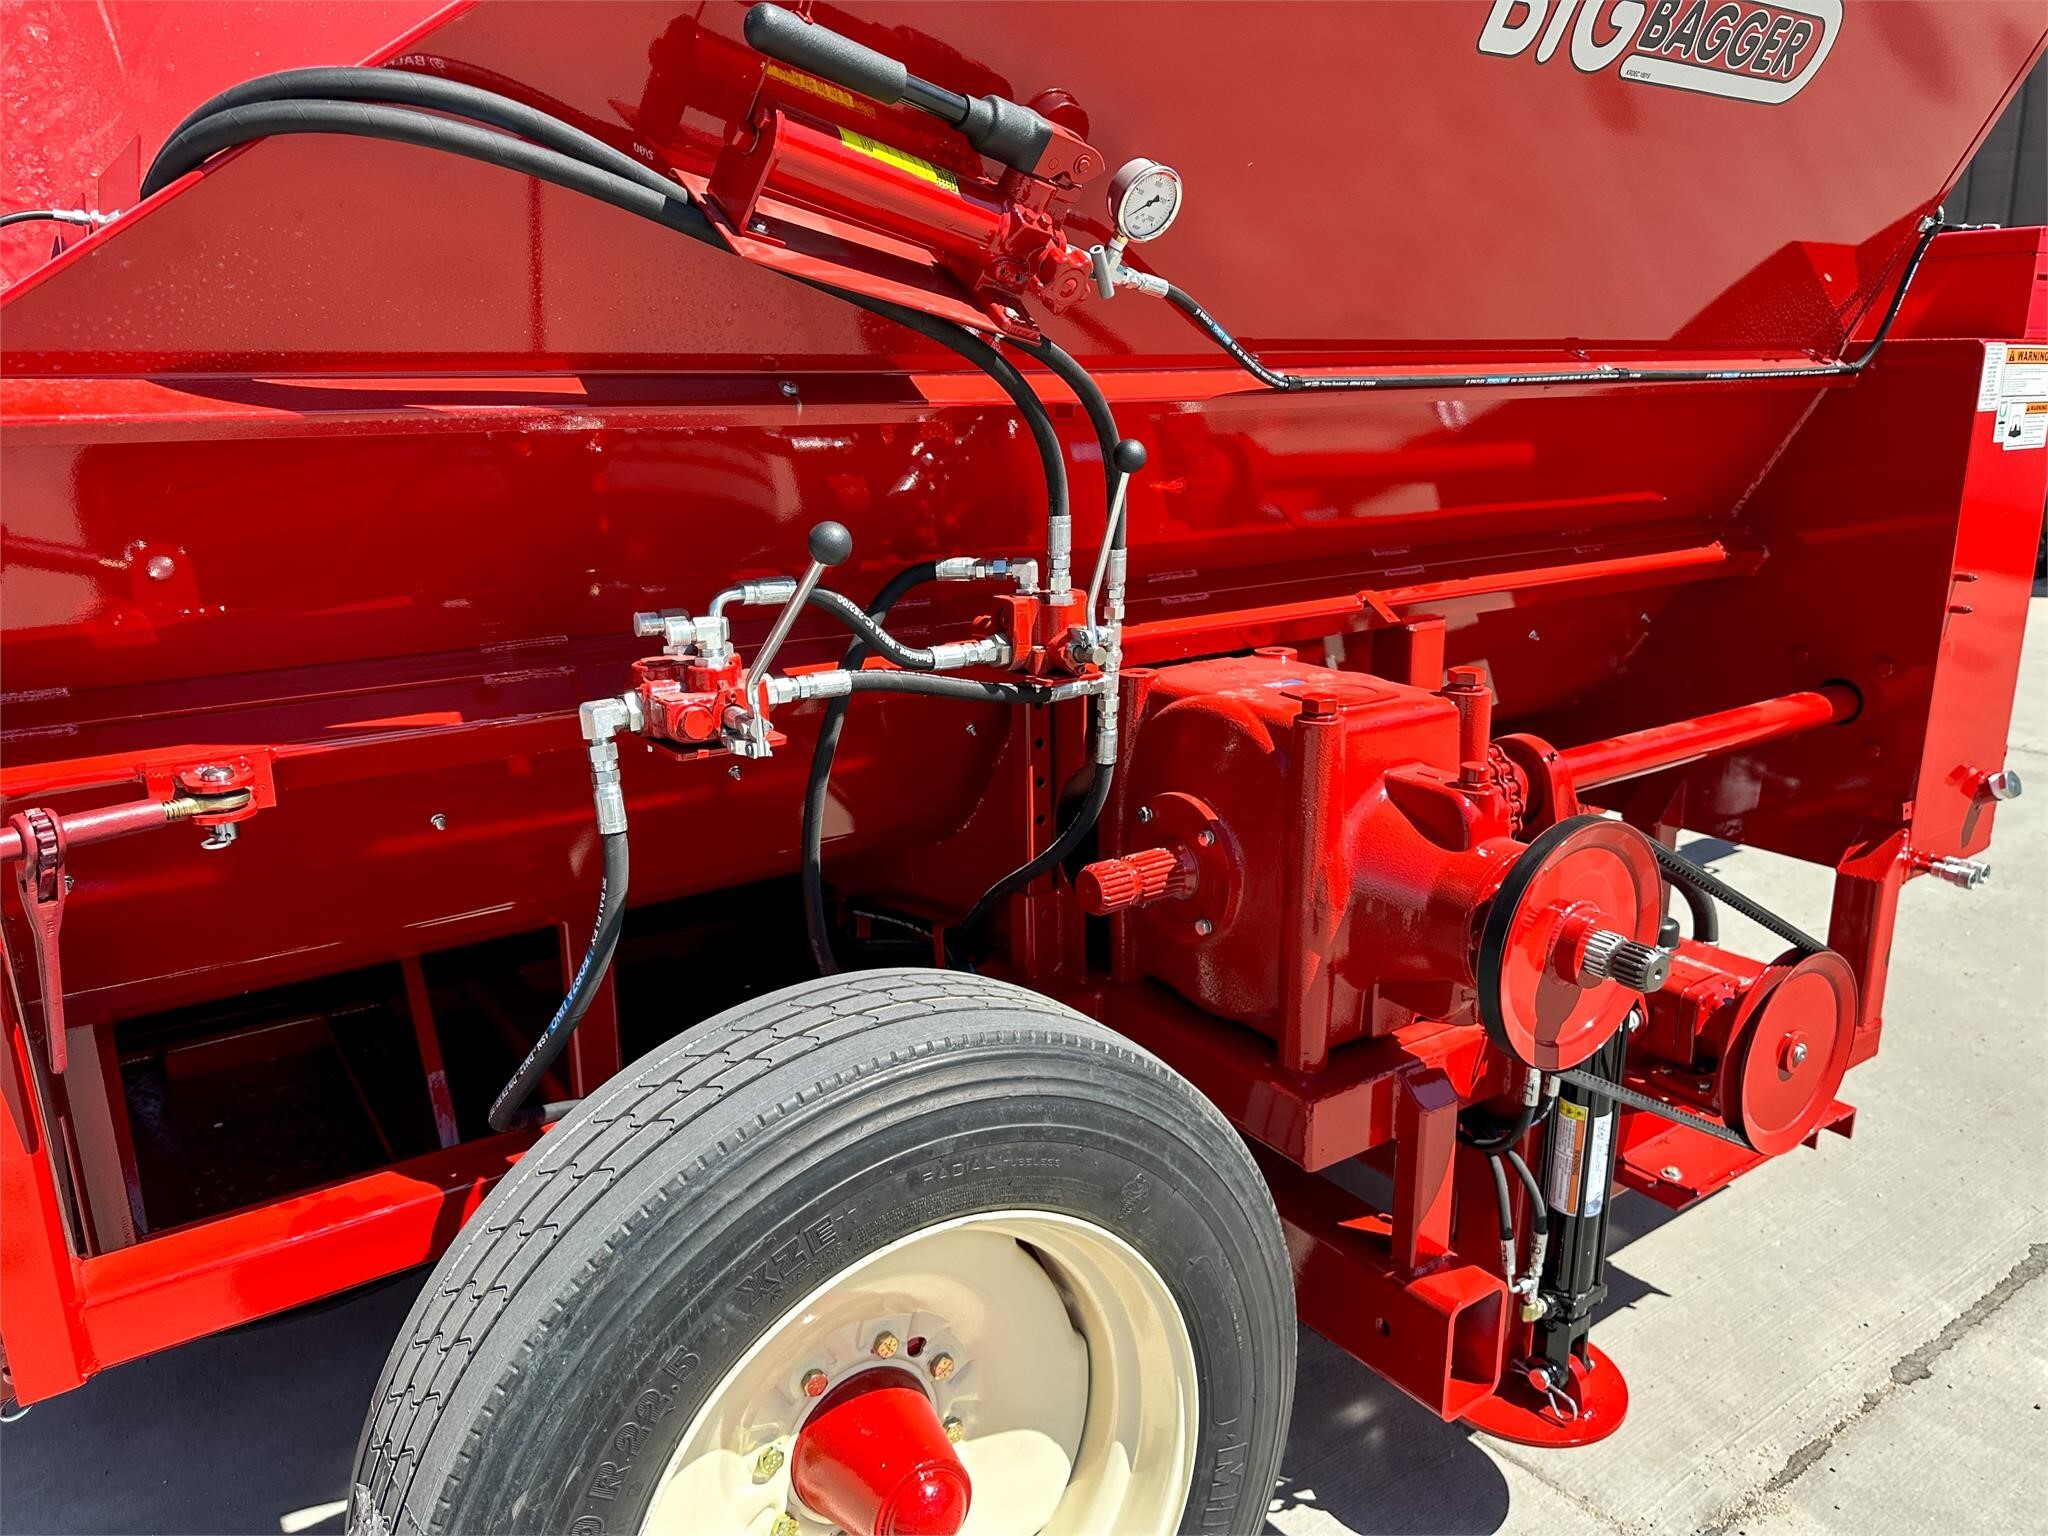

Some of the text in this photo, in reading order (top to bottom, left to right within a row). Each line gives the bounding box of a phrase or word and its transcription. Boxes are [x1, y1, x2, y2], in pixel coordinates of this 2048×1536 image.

[1477, 0, 1812, 77] BIG BAGGER
[2017, 351, 2048, 361] WARNING
[875, 624, 898, 650] MSHA
[922, 1156, 1061, 1187] RADIAL TUBELESS
